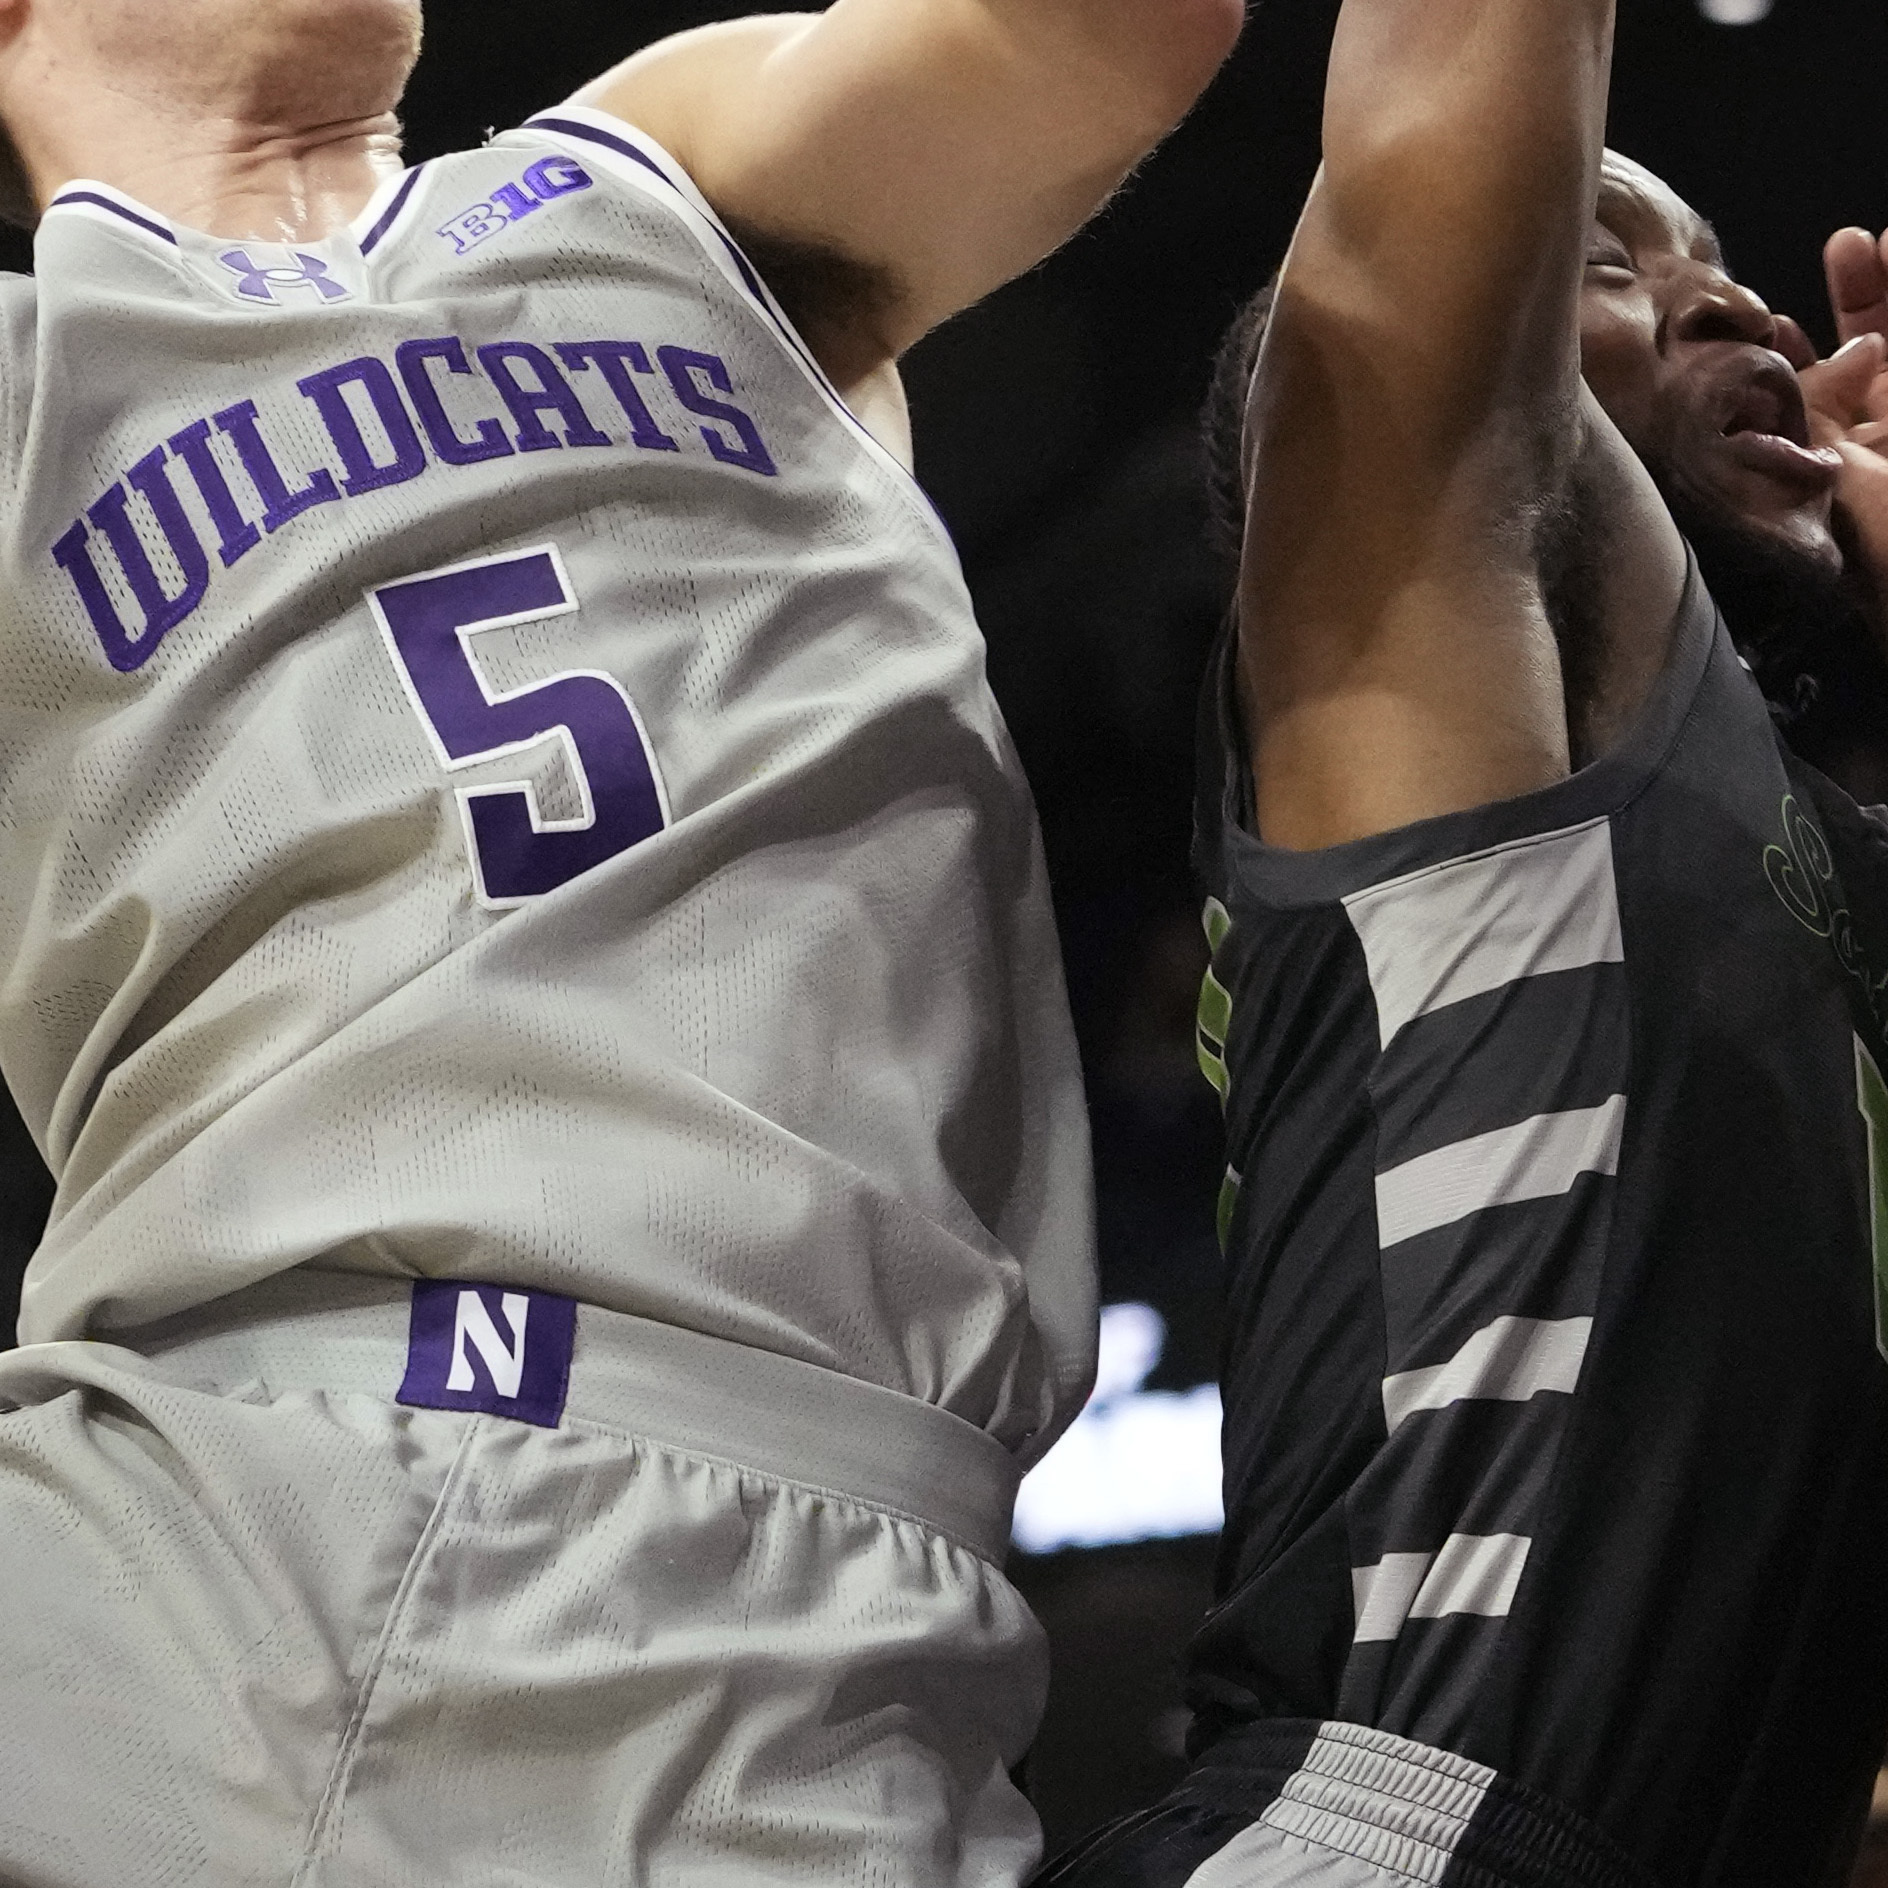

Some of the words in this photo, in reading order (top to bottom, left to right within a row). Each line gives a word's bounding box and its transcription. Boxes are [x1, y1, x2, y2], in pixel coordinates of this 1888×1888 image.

[51, 335, 779, 674] WILDCATS
[362, 542, 674, 911] 5
[446, 1290, 529, 1398] N
